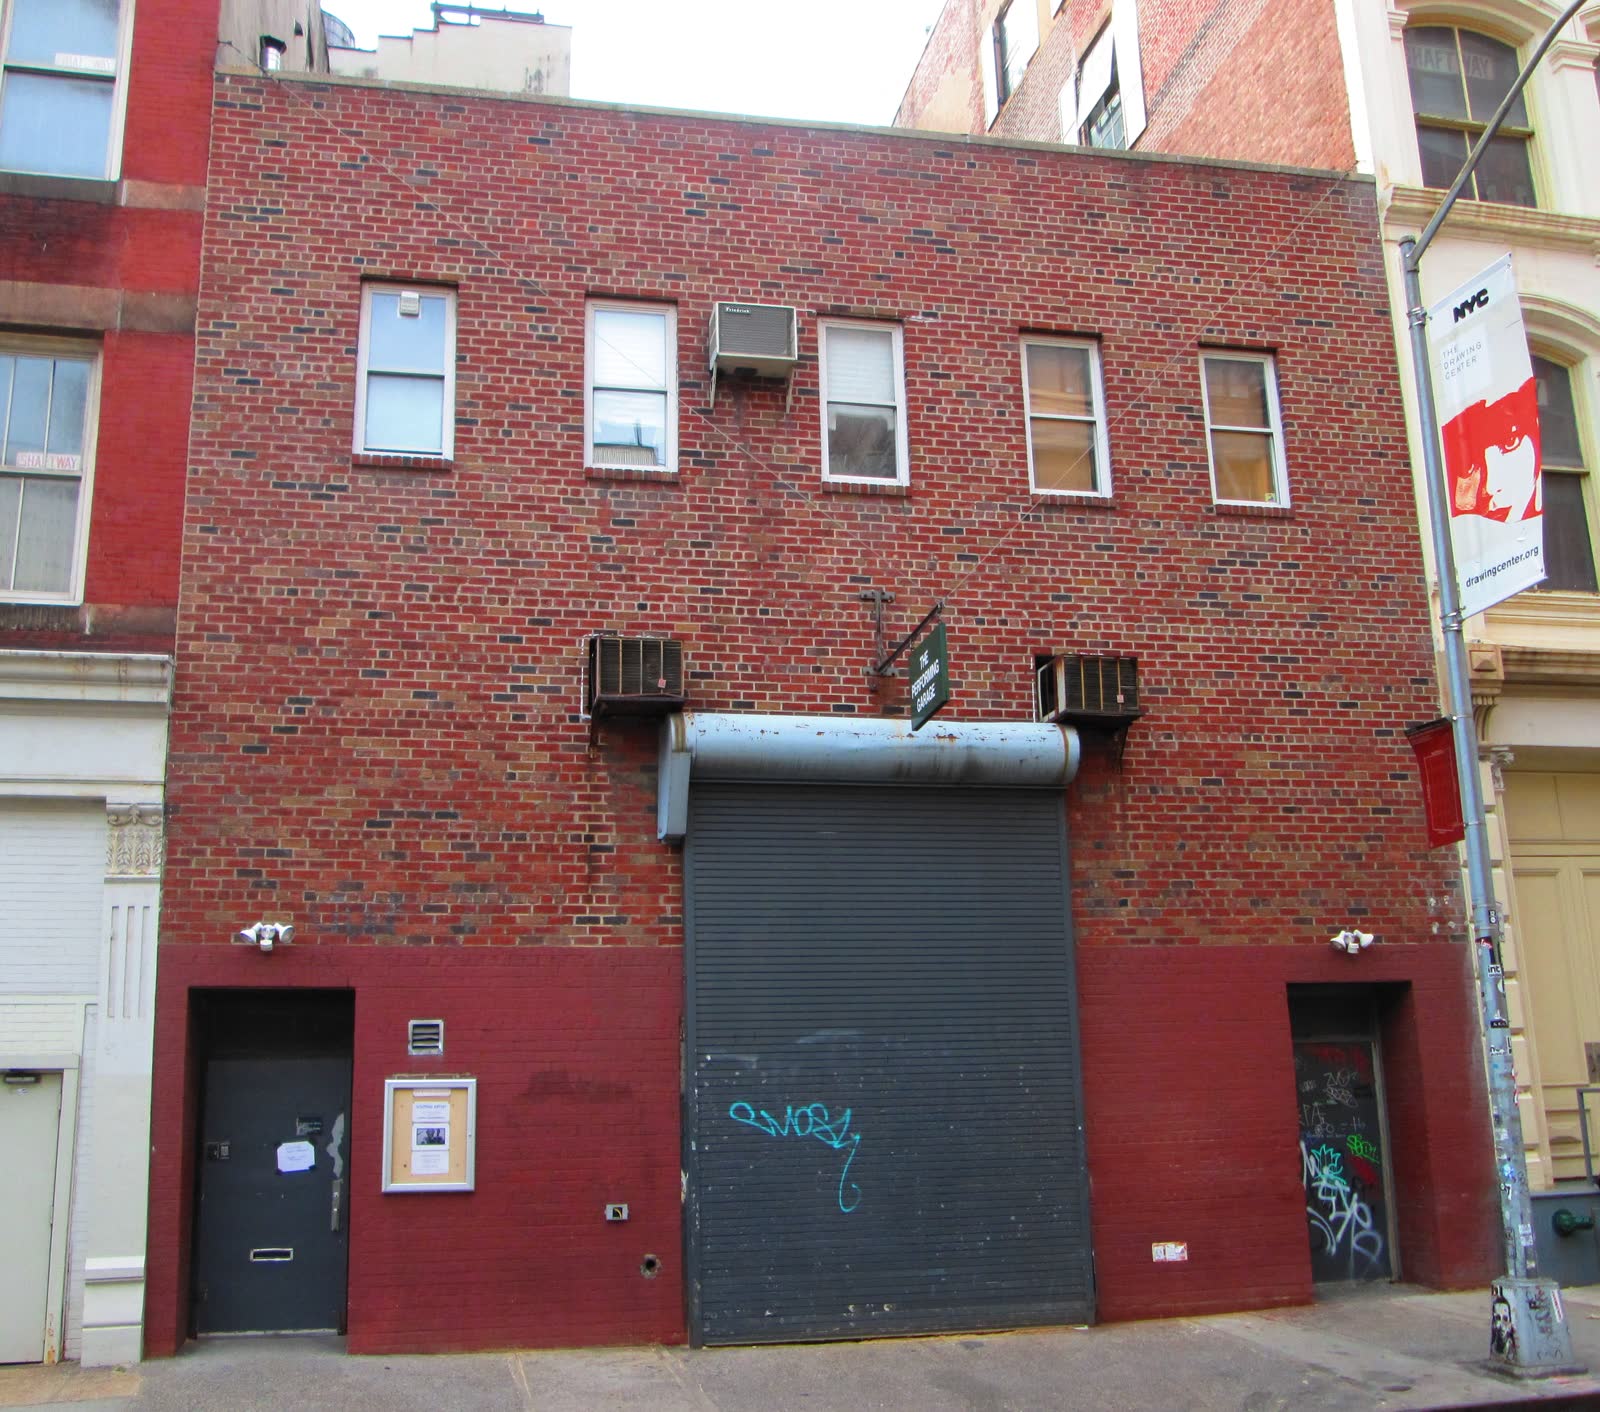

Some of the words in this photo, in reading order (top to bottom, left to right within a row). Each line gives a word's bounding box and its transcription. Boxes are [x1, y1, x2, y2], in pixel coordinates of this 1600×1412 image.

[1453, 288, 1490, 323] NYC
[1443, 346, 1457, 358] THE
[1444, 342, 1482, 369] DRAWING
[1445, 356, 1477, 379] CENTER
[1465, 546, 1539, 587] drawingcenter.org
[919, 650, 929, 670] THE
[911, 659, 939, 699] PERFORMING
[916, 683, 936, 712] GARAGE
